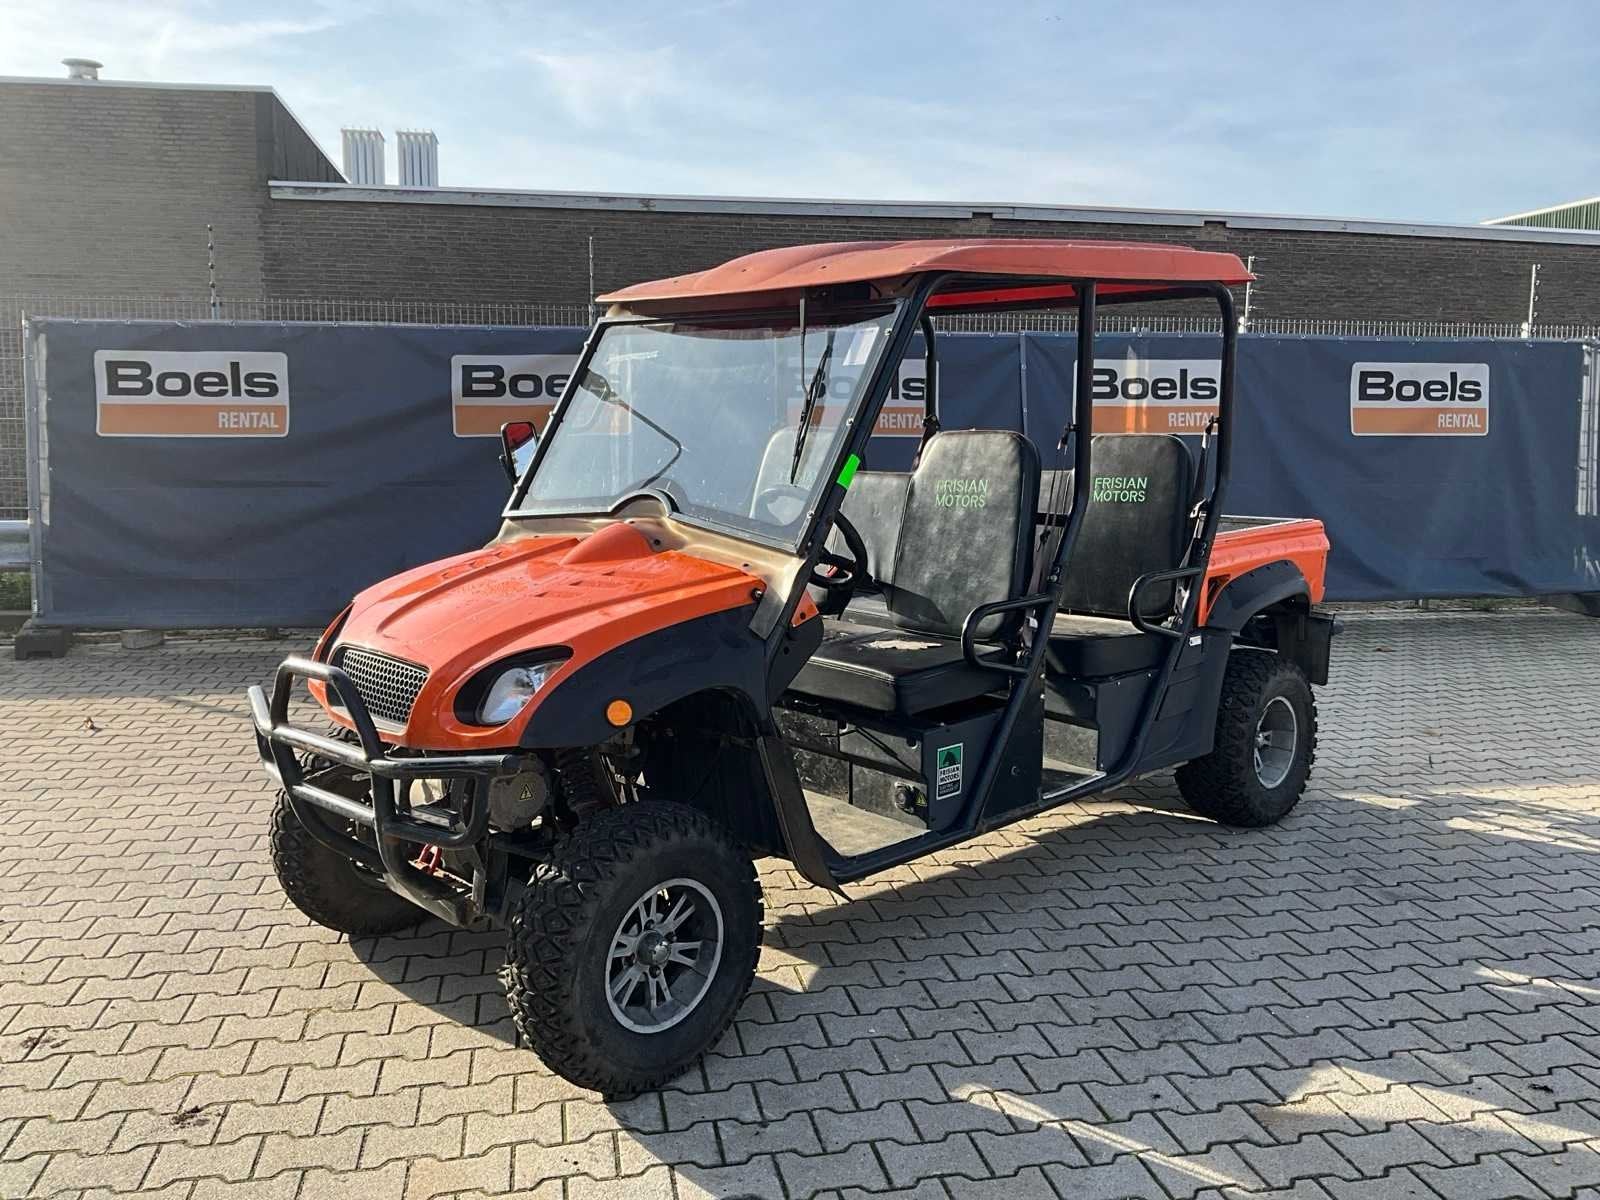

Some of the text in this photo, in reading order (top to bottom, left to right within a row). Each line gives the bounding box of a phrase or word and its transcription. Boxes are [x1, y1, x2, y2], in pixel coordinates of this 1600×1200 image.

[105, 360, 279, 397] Boels
[462, 365, 571, 398] Boe
[1092, 368, 1217, 400] Boels
[1358, 371, 1482, 402] Boels
[218, 411, 279, 429] RENTAL
[879, 413, 923, 429] RENTA
[1437, 414, 1481, 428] RENTAL
[936, 479, 988, 493] FRISIAN
[1094, 477, 1148, 489] FRISIAN
[935, 494, 985, 508] MOTORS
[1093, 490, 1146, 502] MOTORS
